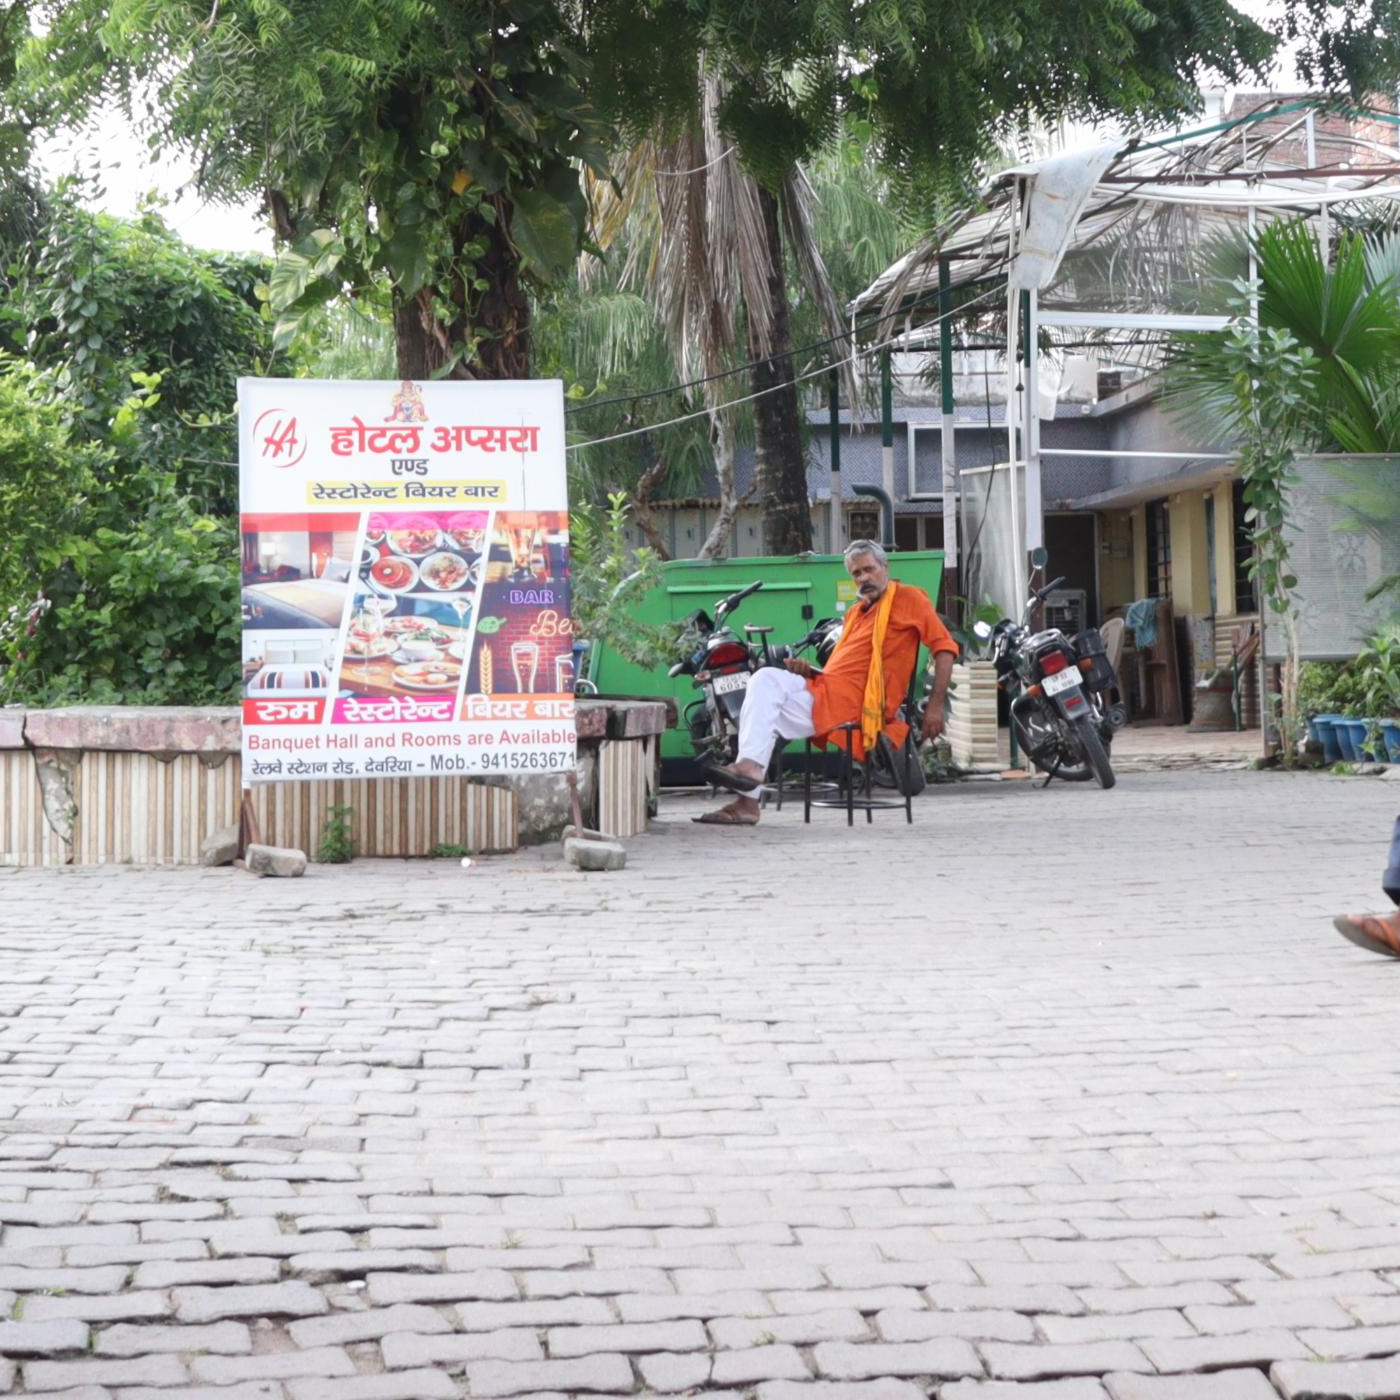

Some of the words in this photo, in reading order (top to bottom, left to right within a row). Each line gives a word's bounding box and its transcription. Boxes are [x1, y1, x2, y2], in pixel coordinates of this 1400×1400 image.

[329, 416, 424, 456] होटल
[430, 425, 540, 452] अप्सरा
[390, 458, 429, 476] एण्ड
[312, 483, 398, 500] रेस्टोरेन्ट
[404, 481, 458, 498] बियर
[464, 485, 500, 498] बार
[509, 589, 554, 604] BAR
[342, 695, 452, 721] रेस्टोरेन्ट
[465, 693, 529, 718] बियर
[534, 700, 577, 718] बार
[248, 734, 320, 753] Banquet
[326, 733, 358, 749] Hall
[364, 732, 396, 748] and
[402, 732, 462, 747] Rooms
[468, 733, 494, 745] are
[499, 729, 577, 745] Available
[251, 758, 283, 775] रेलवे
[286, 758, 328, 774] स्टेशन
[364, 755, 412, 772] देवरिया
[481, 751, 576, 769] 9415263671
